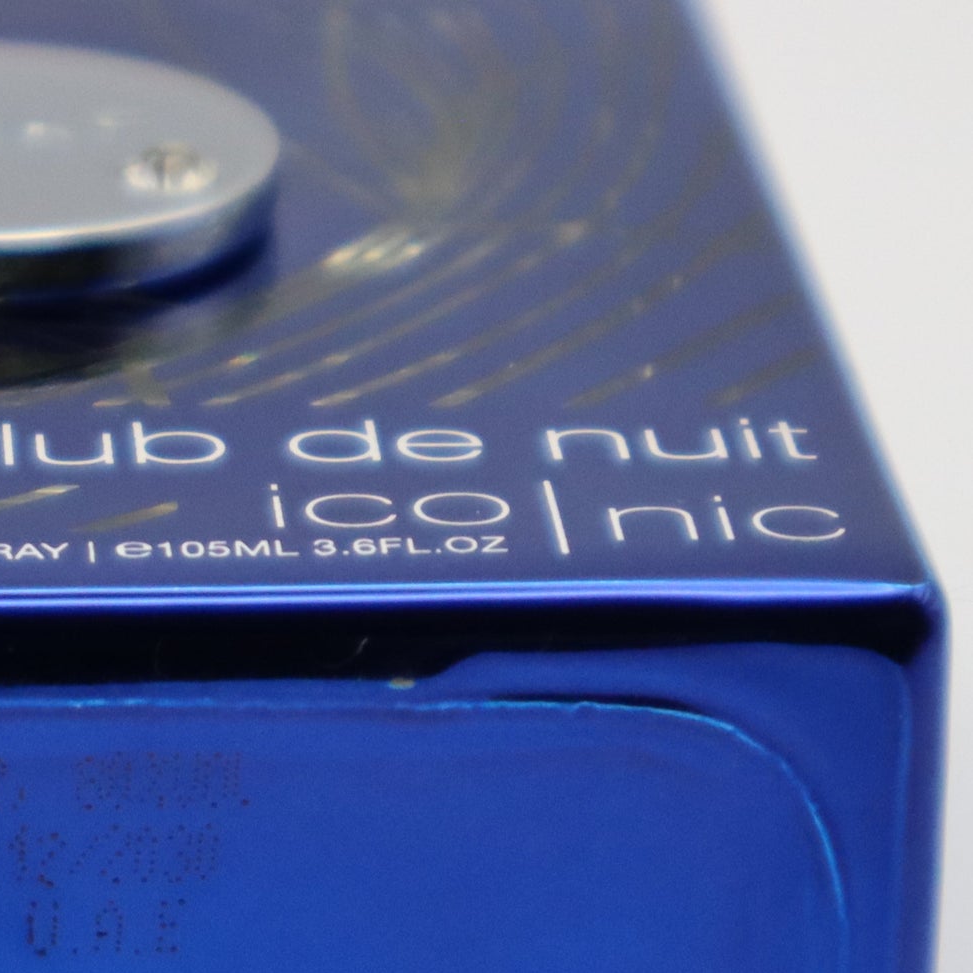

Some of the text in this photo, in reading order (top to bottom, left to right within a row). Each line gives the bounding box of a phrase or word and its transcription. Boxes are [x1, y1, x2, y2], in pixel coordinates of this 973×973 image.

[288, 419, 483, 463] de
[546, 417, 817, 461] nuit
[313, 537, 508, 557] 3.6FL.OZ
